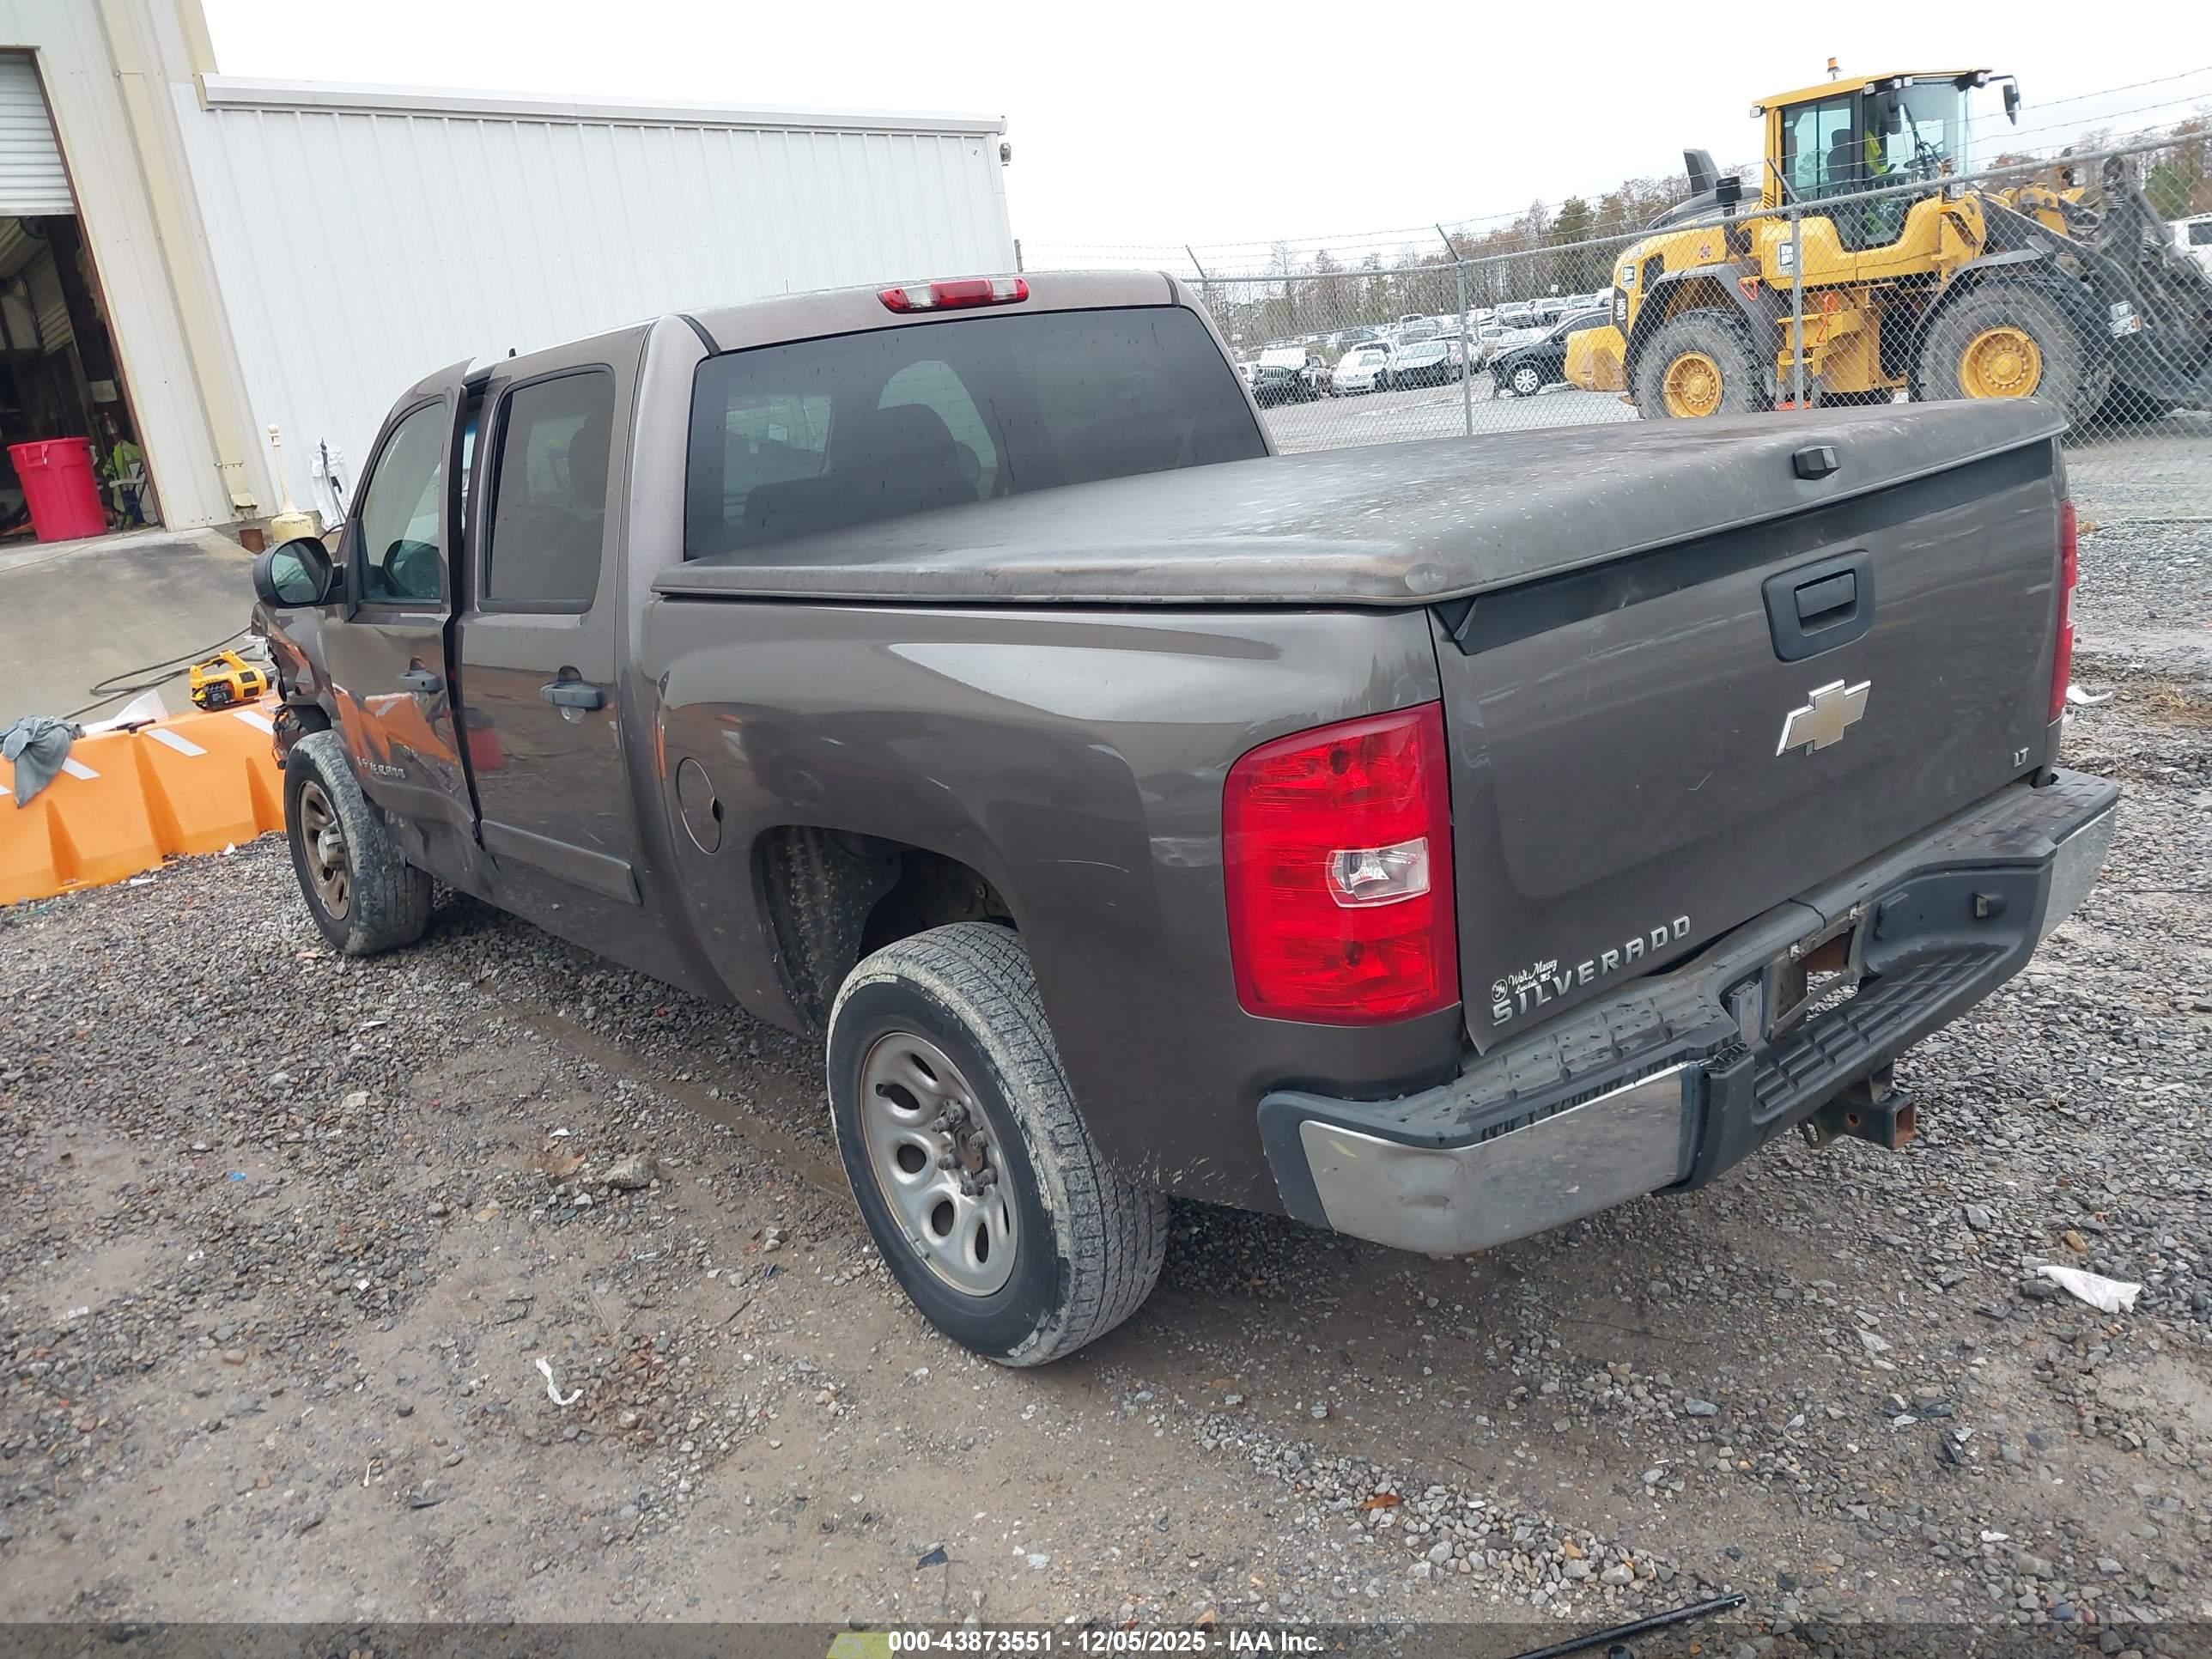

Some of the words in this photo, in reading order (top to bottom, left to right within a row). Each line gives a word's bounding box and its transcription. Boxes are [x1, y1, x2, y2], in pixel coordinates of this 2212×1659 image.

[2013, 747, 2029, 769] LT
[1492, 915, 1691, 1027] SILVERADO
[1529, 959, 1558, 979] Massey
